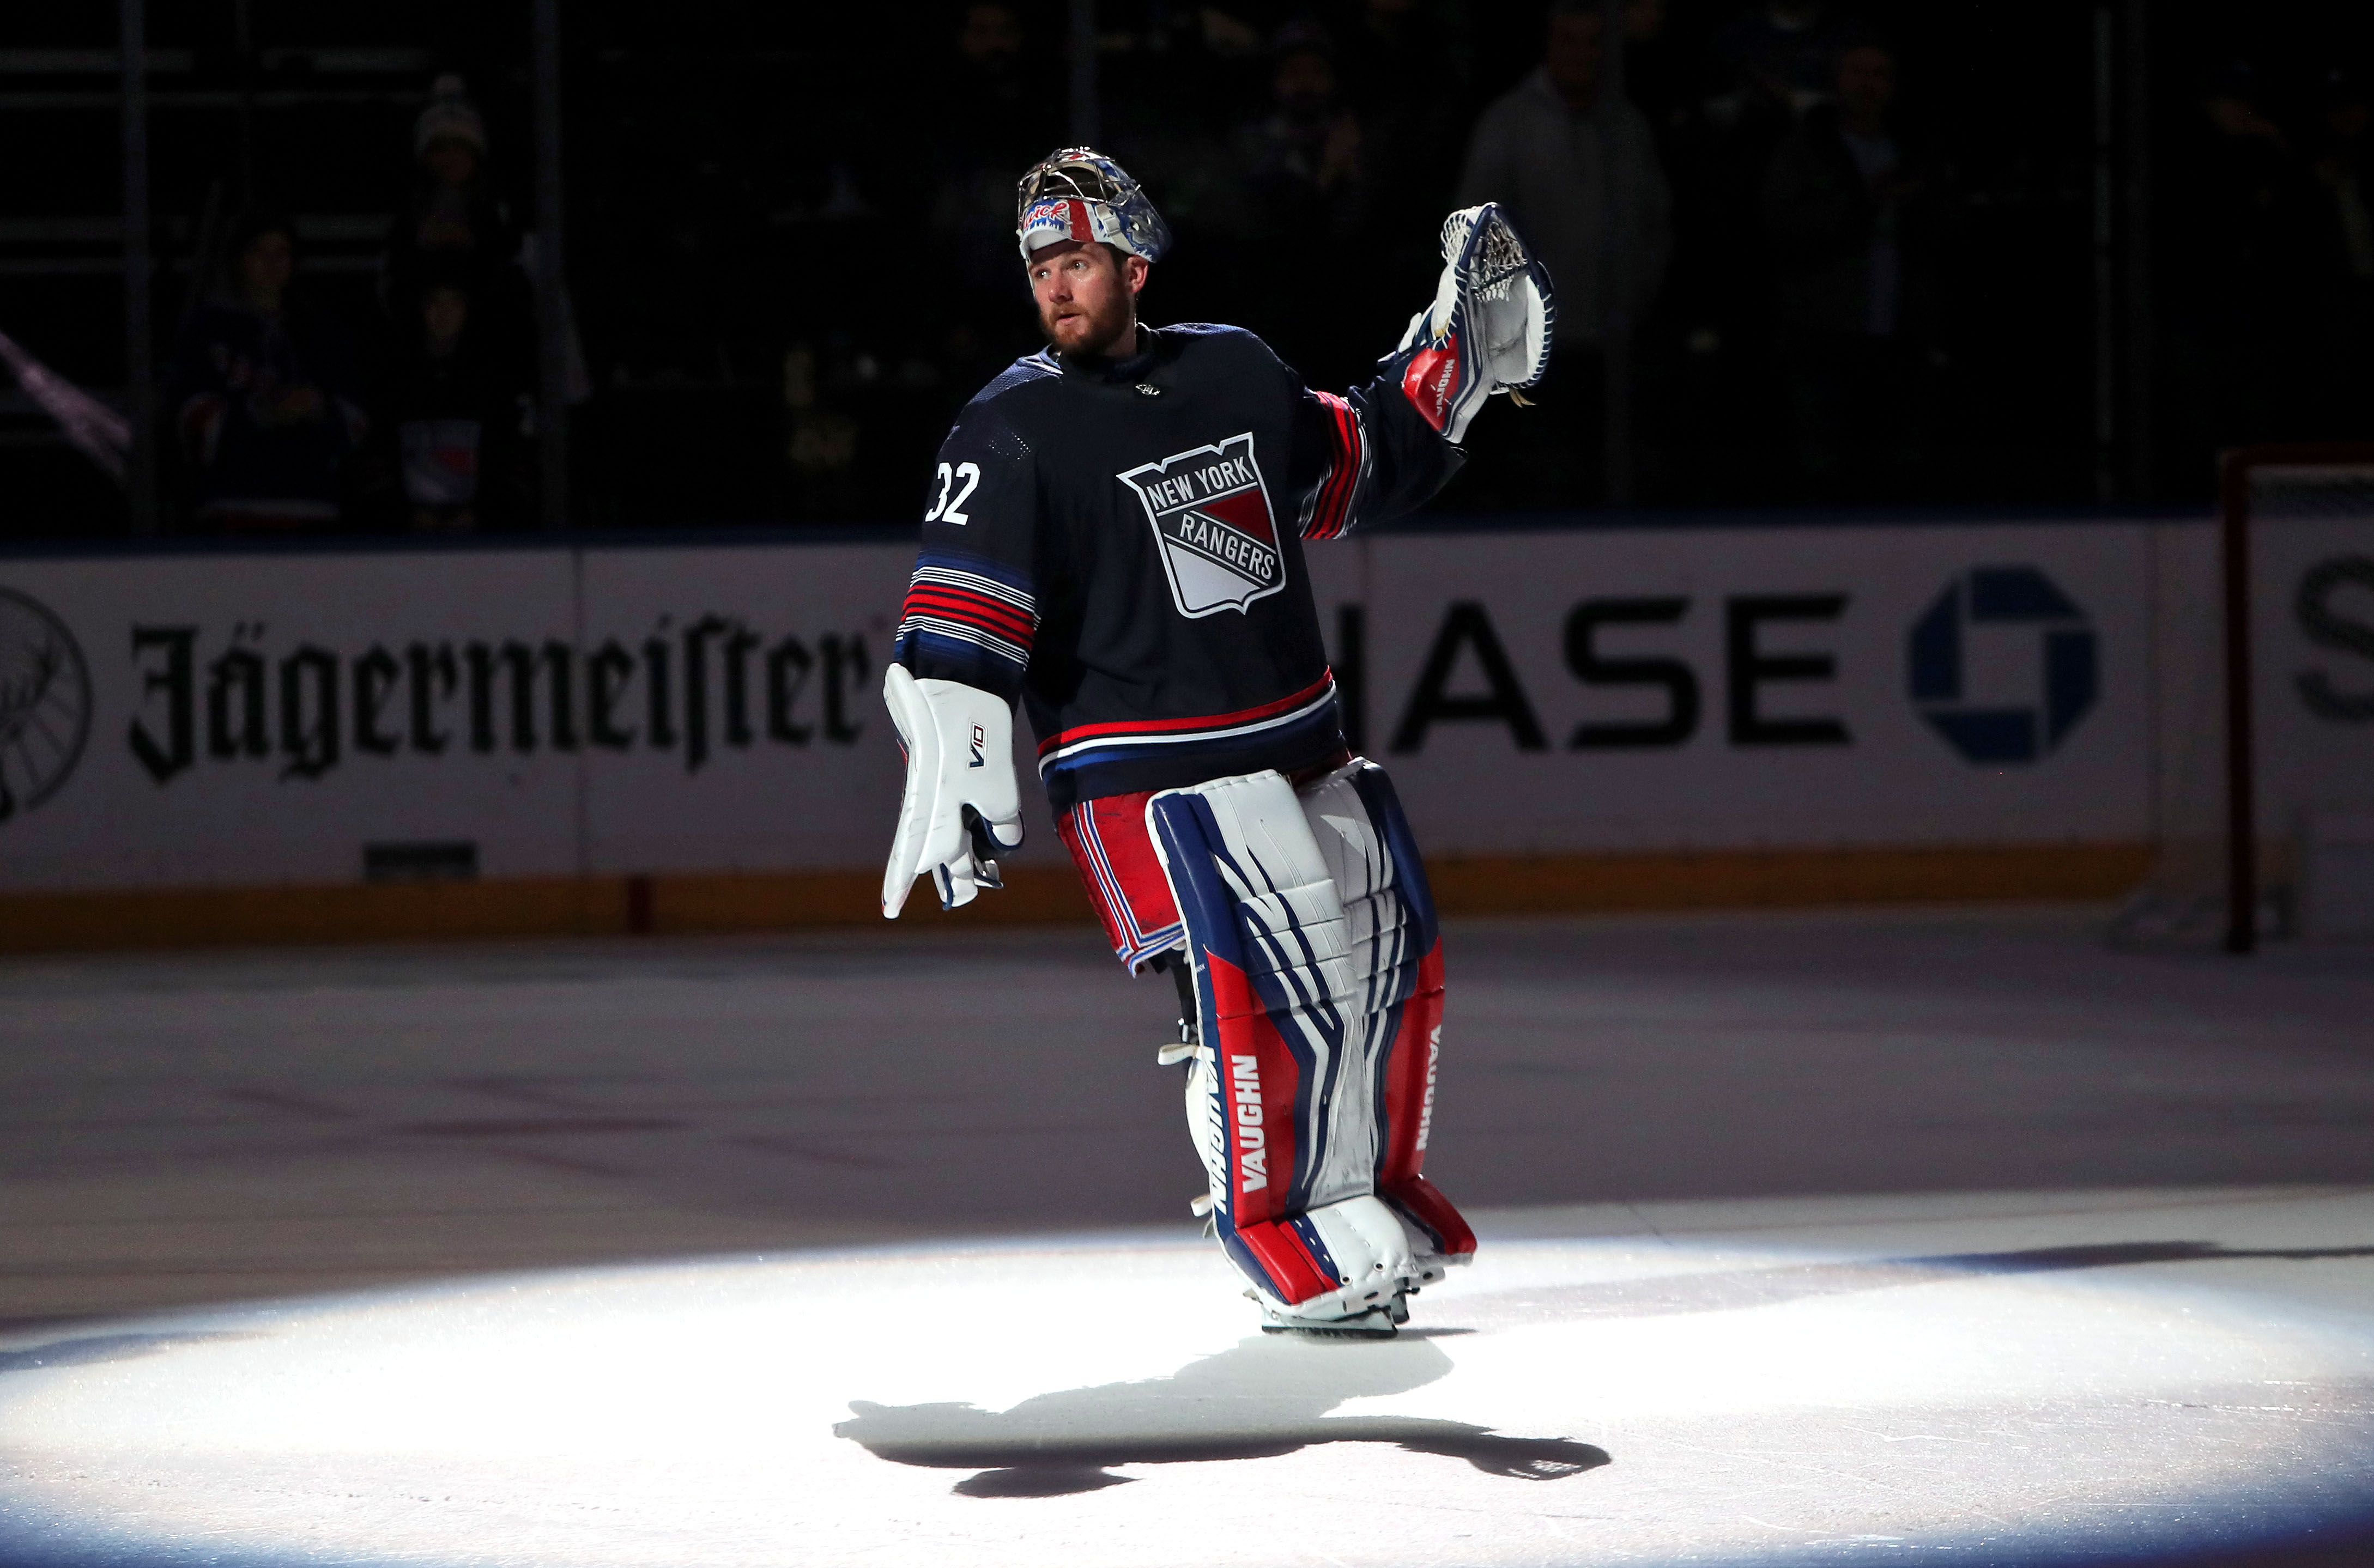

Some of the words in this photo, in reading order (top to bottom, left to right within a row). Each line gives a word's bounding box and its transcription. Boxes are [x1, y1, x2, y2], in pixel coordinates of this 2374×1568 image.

[925, 461, 981, 526] 32
[1146, 473, 1195, 510] NEW
[1194, 456, 1255, 494] YORK
[1179, 513, 1275, 580] RANGERS
[1231, 1054, 1268, 1194] VAUGHN
